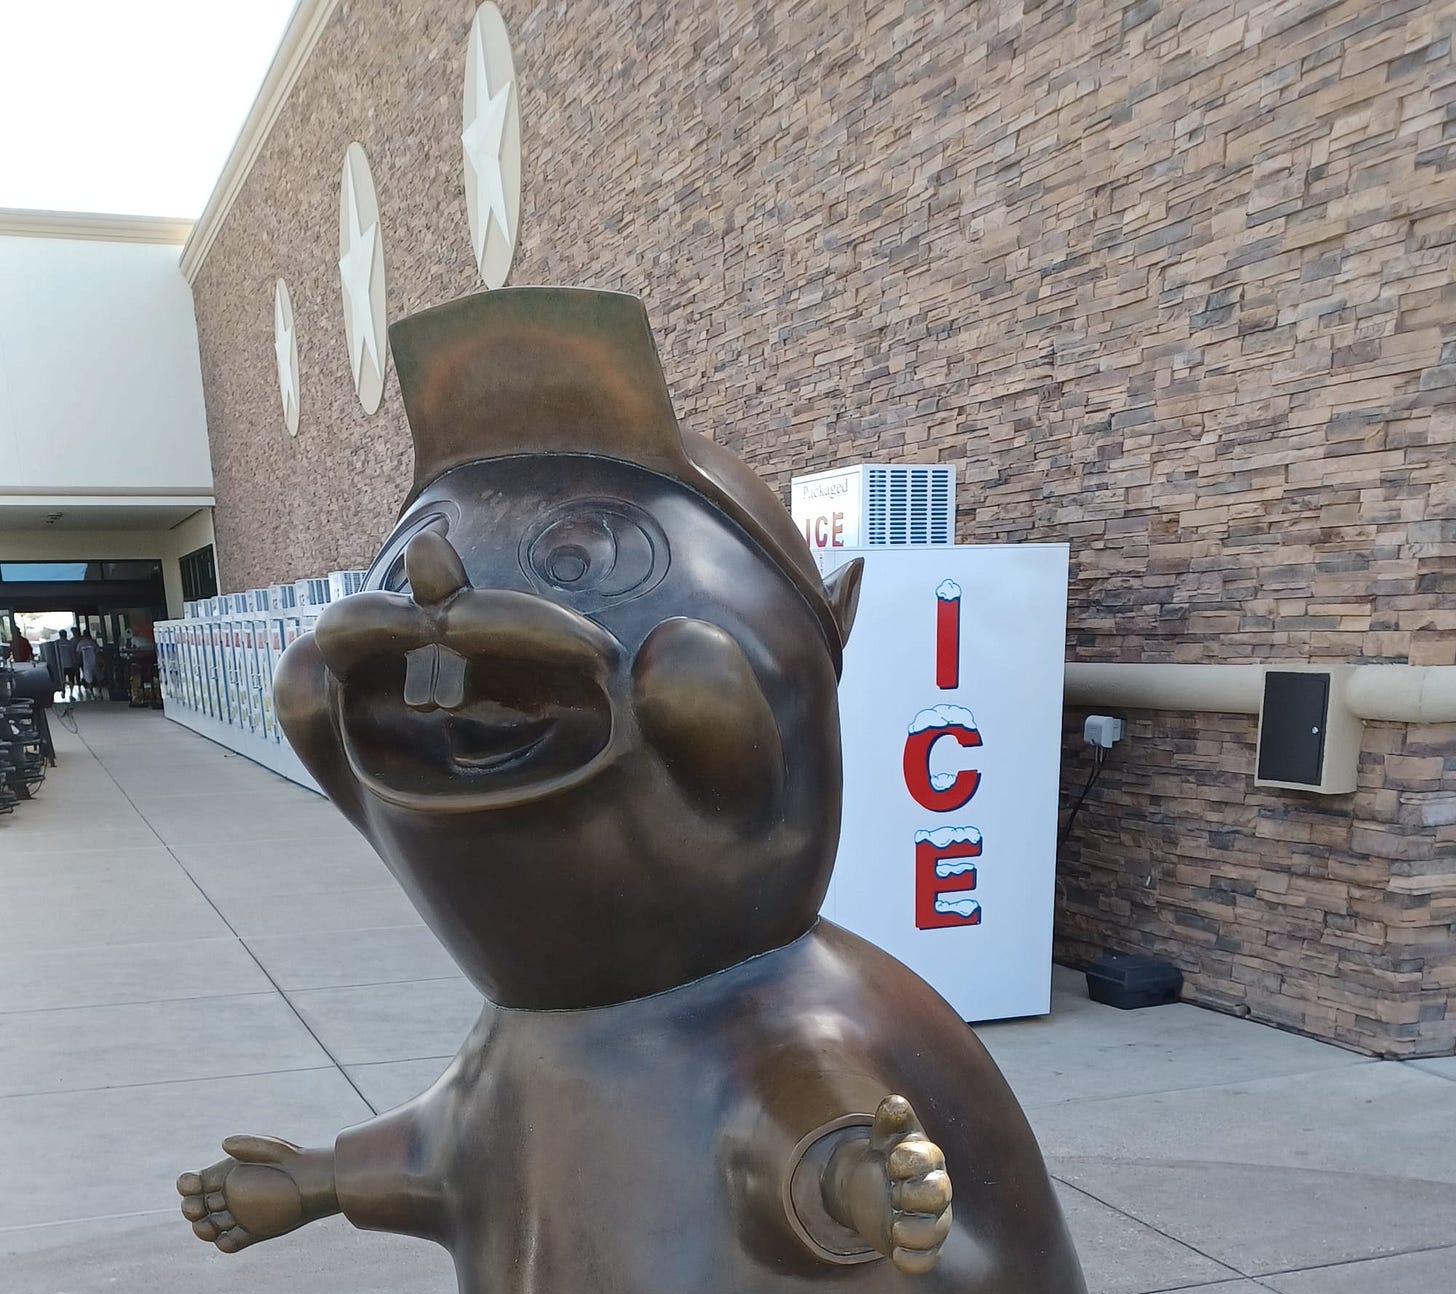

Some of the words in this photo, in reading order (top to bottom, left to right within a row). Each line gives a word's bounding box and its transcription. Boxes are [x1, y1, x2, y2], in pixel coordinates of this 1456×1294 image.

[803, 478, 848, 499] Packaged
[805, 512, 844, 548] ICE
[903, 579, 983, 930] ICE
